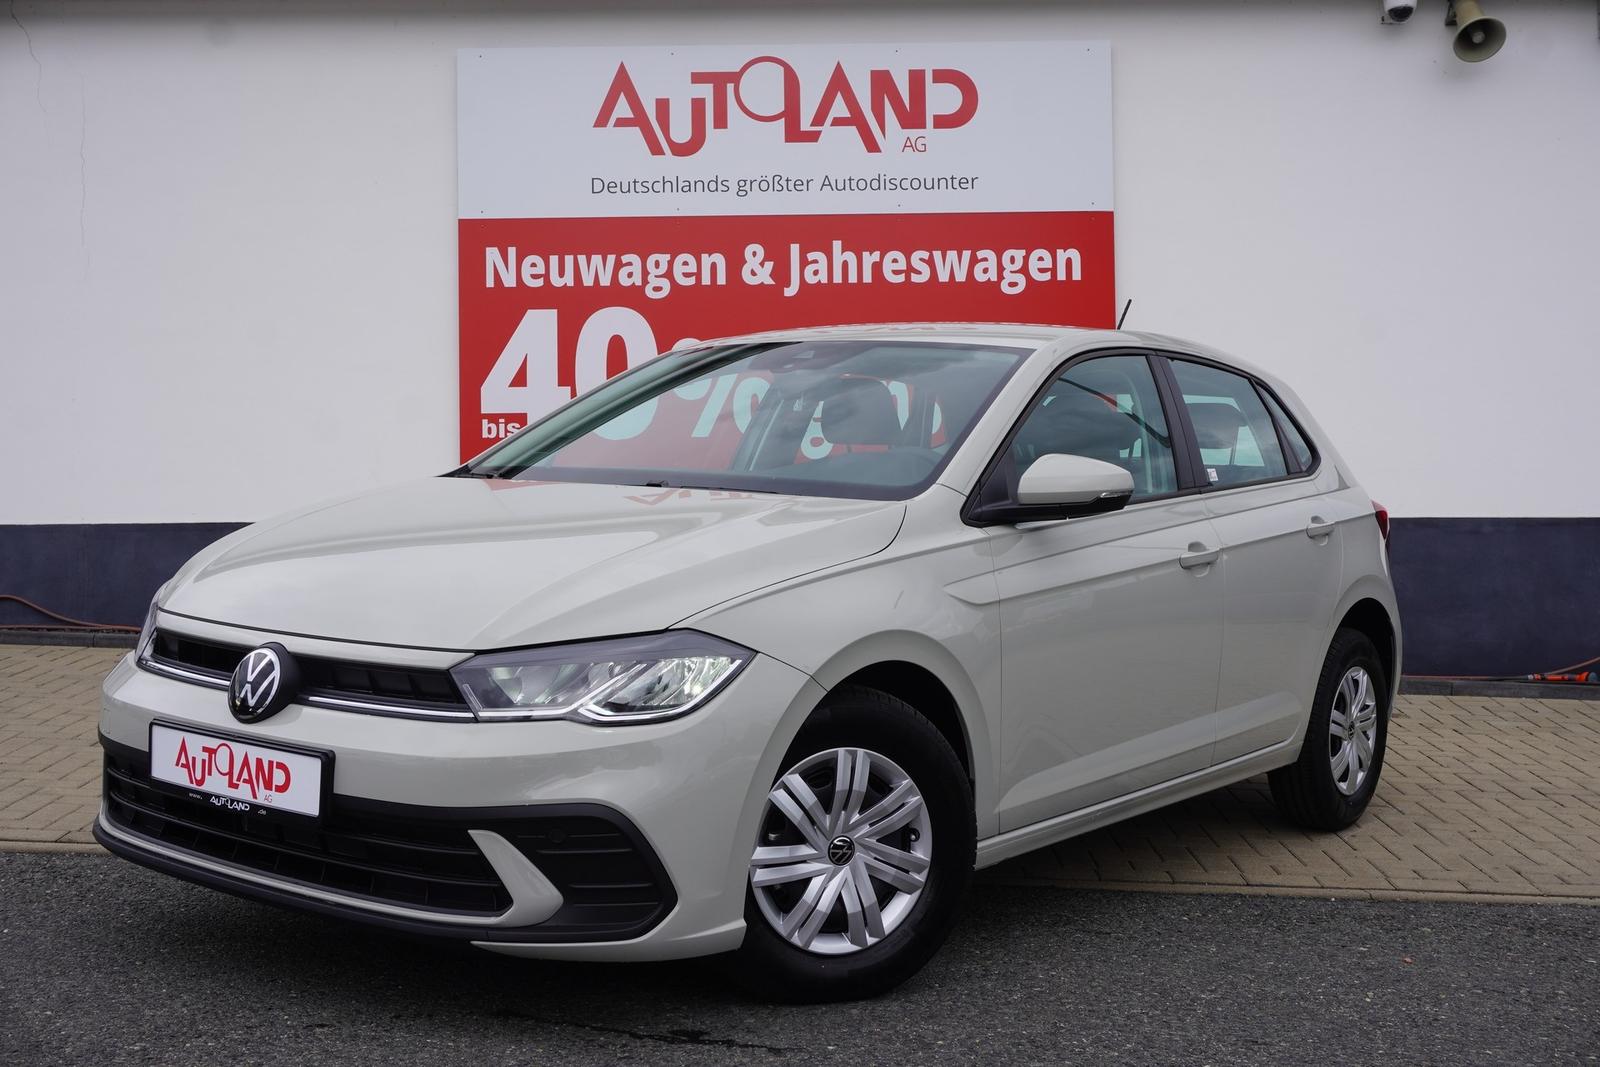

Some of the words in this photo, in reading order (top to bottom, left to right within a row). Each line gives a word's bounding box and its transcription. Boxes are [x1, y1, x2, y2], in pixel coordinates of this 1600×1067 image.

[592, 55, 979, 157] AUTOLAND
[901, 136, 928, 153] AG
[591, 174, 730, 195] Deutschlands
[736, 174, 814, 198] größter
[819, 173, 979, 193] Autodiscounter
[485, 245, 727, 299] Neuwagen
[741, 243, 776, 286] &
[783, 240, 1082, 297] Jahreswagen
[481, 418, 522, 439] bis
[175, 736, 292, 800] AUTOLAND
